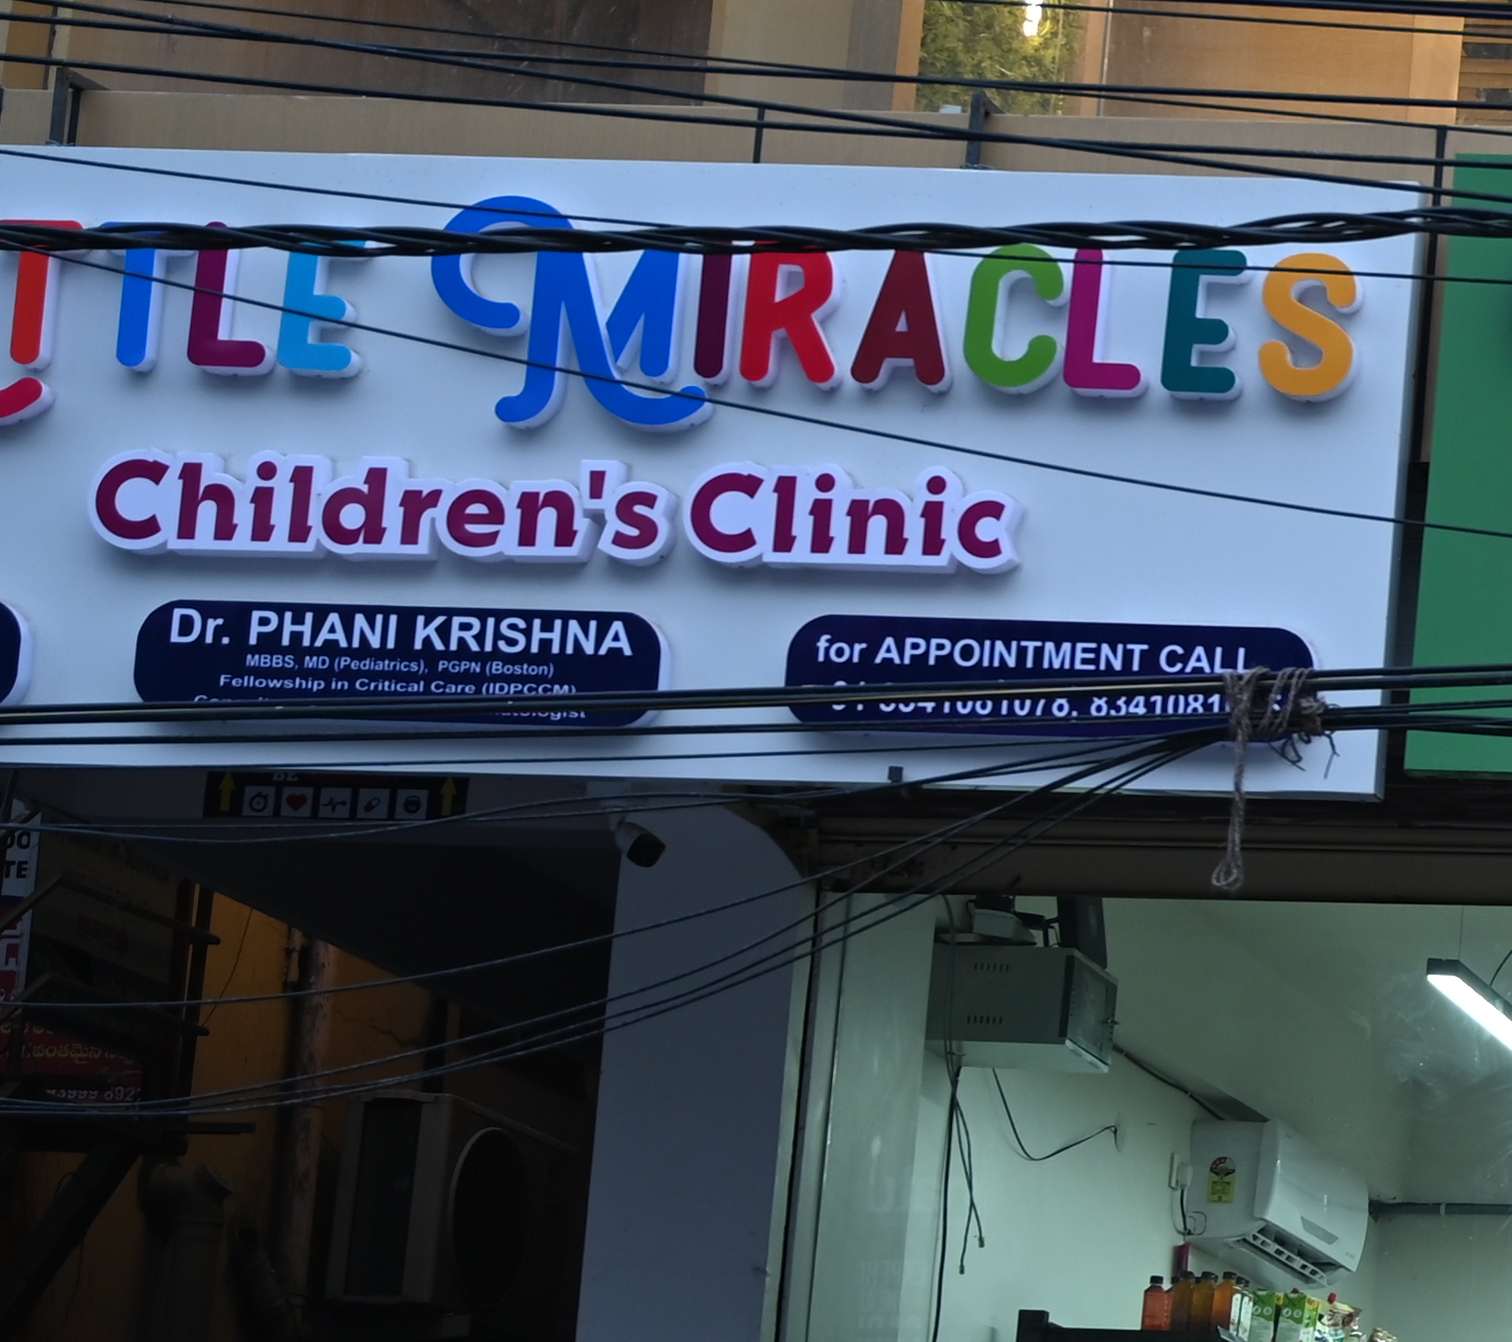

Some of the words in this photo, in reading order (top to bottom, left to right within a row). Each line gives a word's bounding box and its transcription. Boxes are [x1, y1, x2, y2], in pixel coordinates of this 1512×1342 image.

[0, 218, 364, 421] TTLE
[430, 195, 1358, 425] MIRACLES
[93, 455, 661, 553] Children's
[690, 469, 1008, 560] Clinic
[169, 606, 230, 645] Dr.
[248, 609, 398, 650] PHANI
[413, 614, 634, 657] KRISHNA
[816, 634, 868, 664] for
[873, 636, 1149, 672] APPOINTMENT
[1158, 644, 1249, 674] CALL
[219, 673, 326, 693] Fellowship
[331, 677, 349, 691] in
[354, 677, 425, 693] Critical
[430, 680, 476, 695] Care
[245, 653, 299, 671] MBBS,
[303, 655, 330, 670] MD
[334, 655, 429, 676] (Pediatrics),
[437, 660, 481, 675] PGPN
[485, 660, 555, 679] (Boston)
